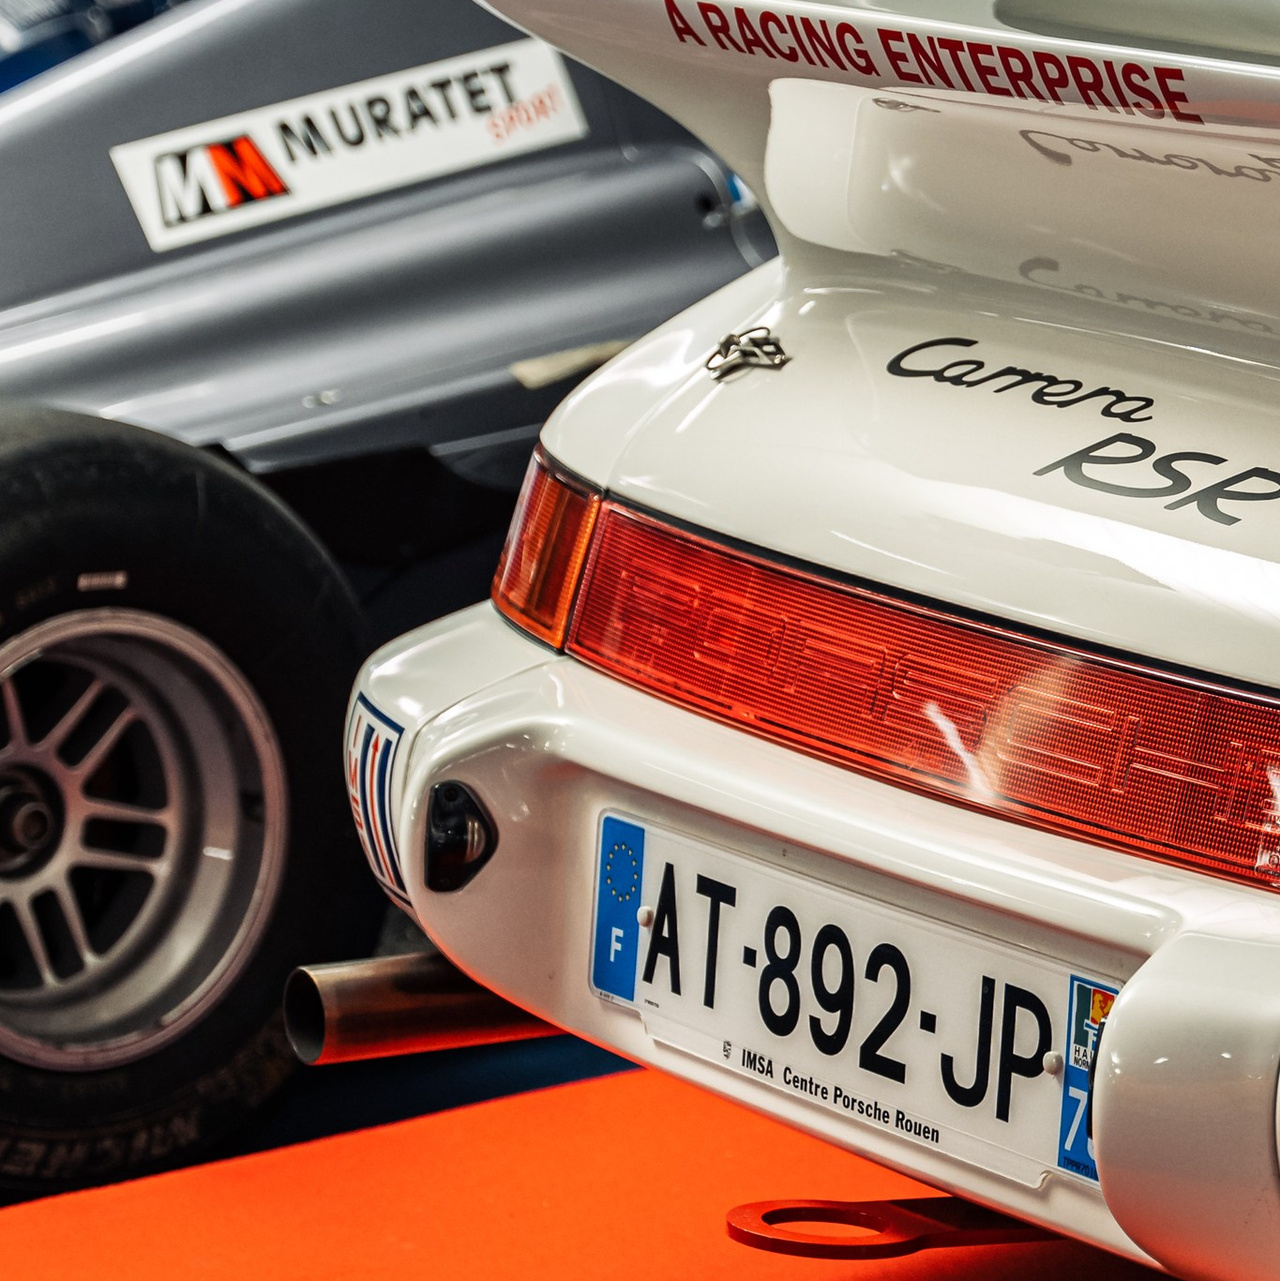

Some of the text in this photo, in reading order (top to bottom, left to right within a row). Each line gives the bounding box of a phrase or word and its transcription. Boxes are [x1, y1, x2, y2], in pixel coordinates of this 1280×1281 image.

[277, 61, 523, 163] MURATET
[697, 1, 882, 77] RACING
[876, 28, 1206, 125] ENTERPRISE
[886, 337, 1154, 423] Carrera
[609, 927, 624, 963] F
[642, 862, 1052, 1123] AT-892-JP
[742, 1048, 939, 1144] IMSA Centre Porsche Rouen
